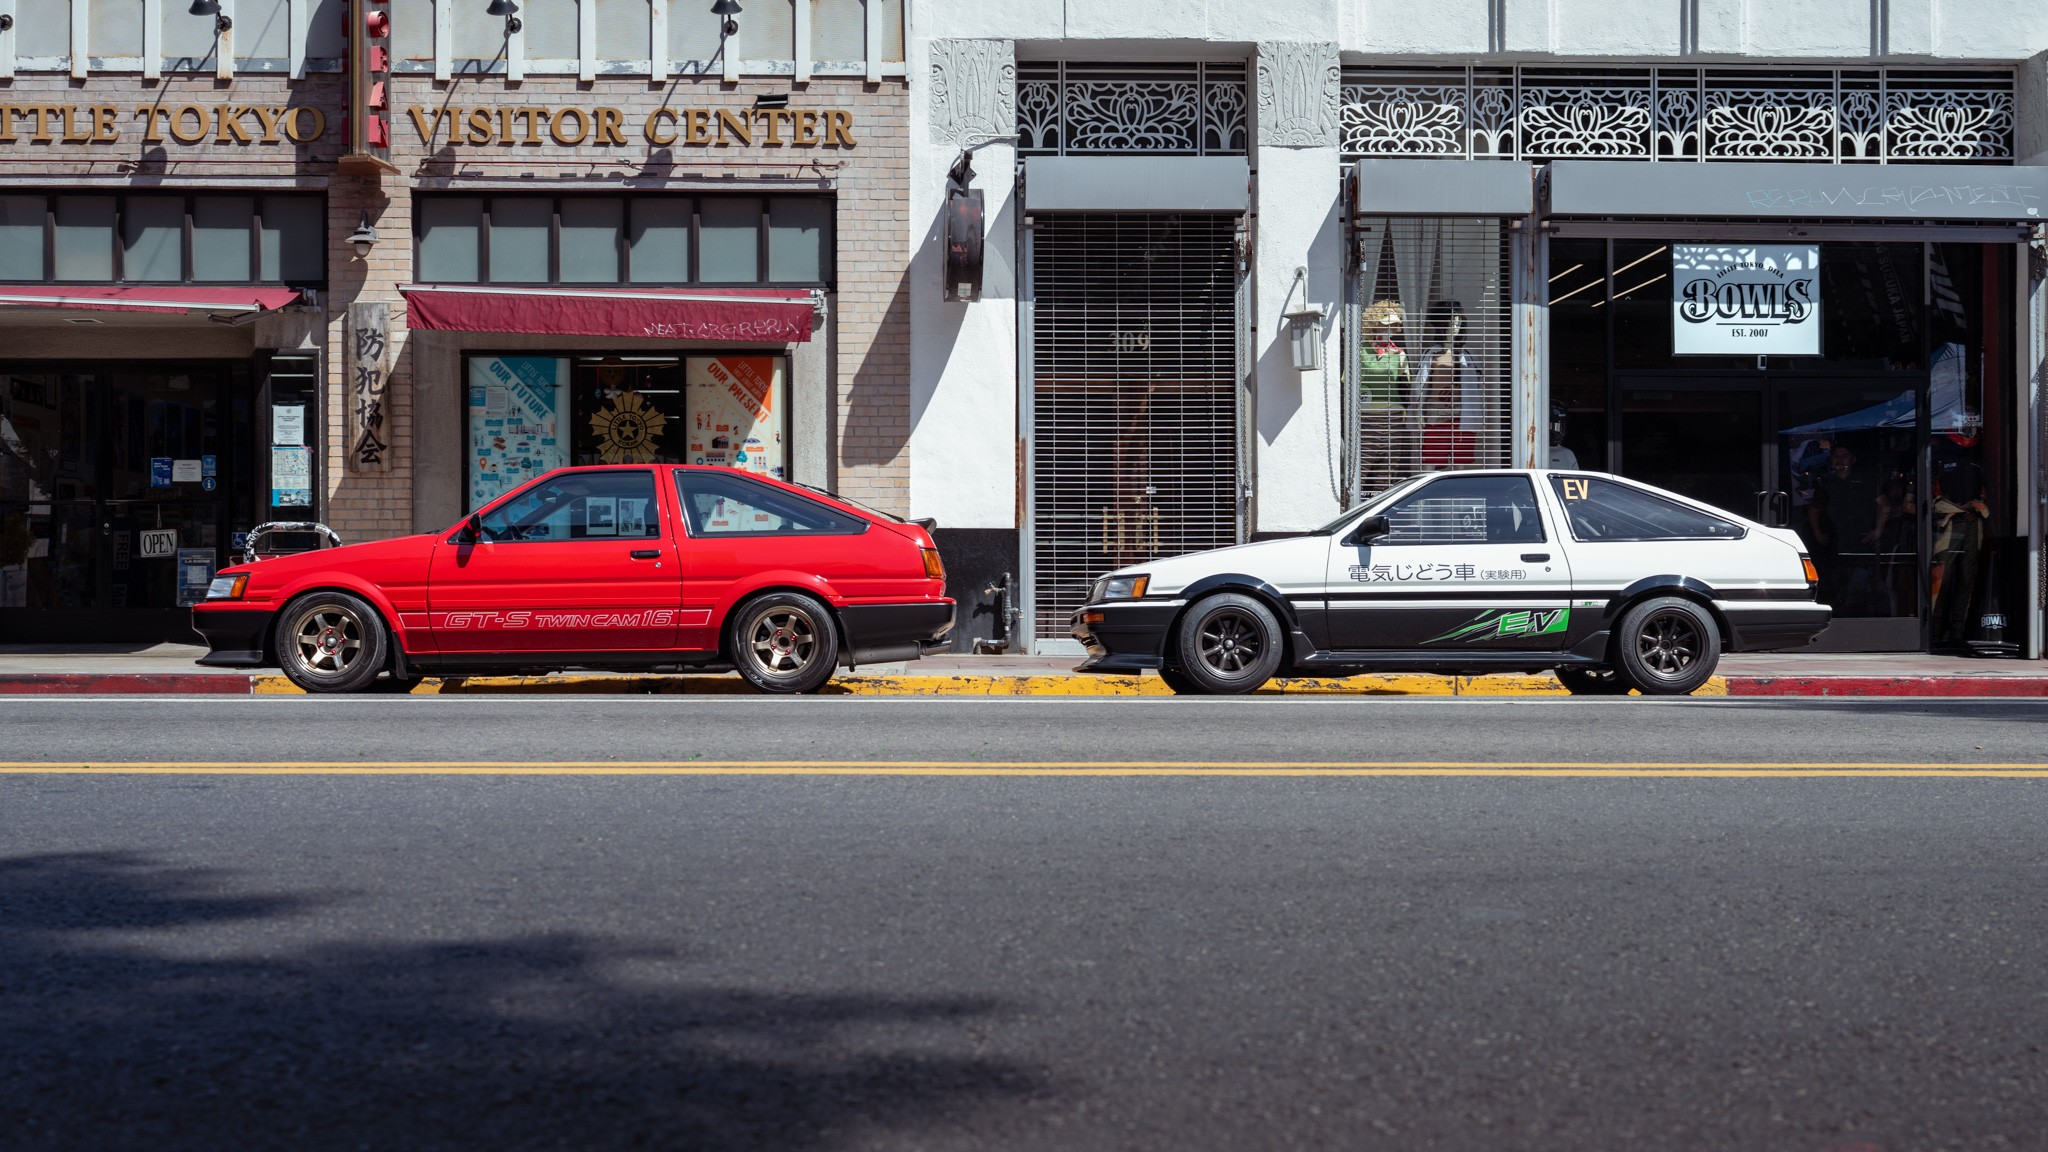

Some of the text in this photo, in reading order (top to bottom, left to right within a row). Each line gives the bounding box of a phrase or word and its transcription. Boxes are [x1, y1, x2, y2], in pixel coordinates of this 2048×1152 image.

[366, 0, 389, 148] OBAN
[134, 104, 325, 143] TOKYO
[407, 105, 857, 150] VISITOR CENTER
[1716, 264, 1737, 278] LITTLE
[1767, 265, 1784, 279] DTLA
[1680, 278, 1813, 324] BOWLS
[1732, 329, 1769, 338] EST. 2007
[1892, 304, 1912, 344] JAPAN
[1107, 331, 1150, 353] 309
[355, 326, 387, 466] 防犯協会
[489, 360, 512, 385] OUR
[511, 381, 550, 421] FUTURE
[707, 361, 729, 386] OUR
[727, 382, 769, 424] PRESENT
[1562, 478, 1589, 500] EV
[115, 533, 129, 569] FREE
[143, 533, 174, 555] OPEN
[1348, 563, 1476, 583] 電気じどう車
[444, 611, 532, 629] GT-S
[1497, 608, 1563, 635] EV
[1980, 616, 2008, 628] BOWLS
